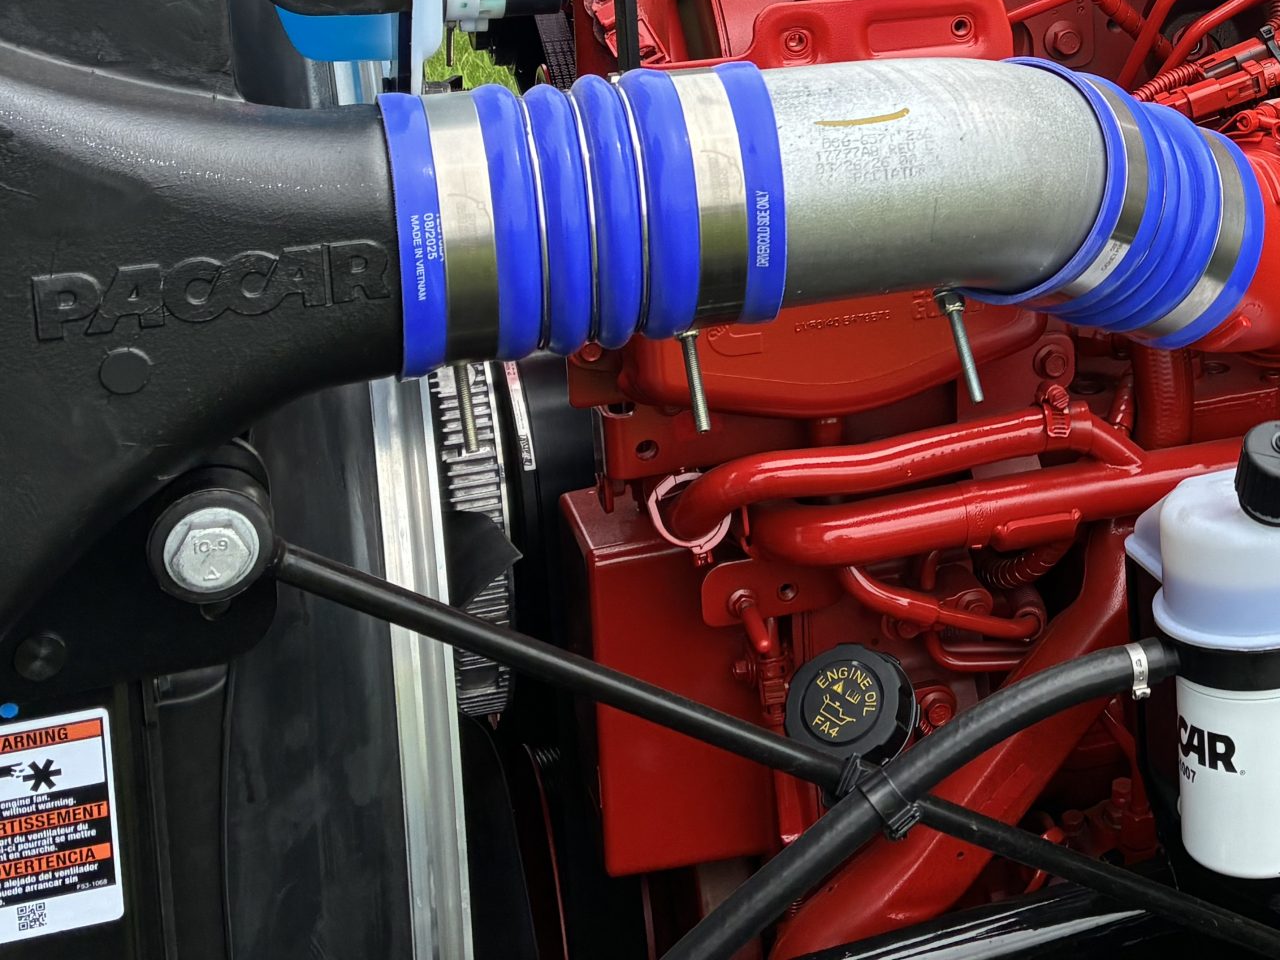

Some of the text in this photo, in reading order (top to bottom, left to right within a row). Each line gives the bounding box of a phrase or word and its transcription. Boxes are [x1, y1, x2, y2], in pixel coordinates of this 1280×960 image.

[423, 212, 438, 260] 08/2025
[410, 214, 427, 301] MADE IN VIETNAM
[32, 240, 391, 340] PACCAR
[816, 667, 877, 717] ENGINE OIL
[1, 727, 68, 751] ARNING
[812, 715, 840, 738] FA4
[1179, 714, 1238, 774] CAR
[0, 794, 50, 810] engine fan.
[2, 797, 76, 817] without warning.
[0, 803, 104, 835] RTISSEMENT
[1, 848, 96, 876] VERTENCIA
